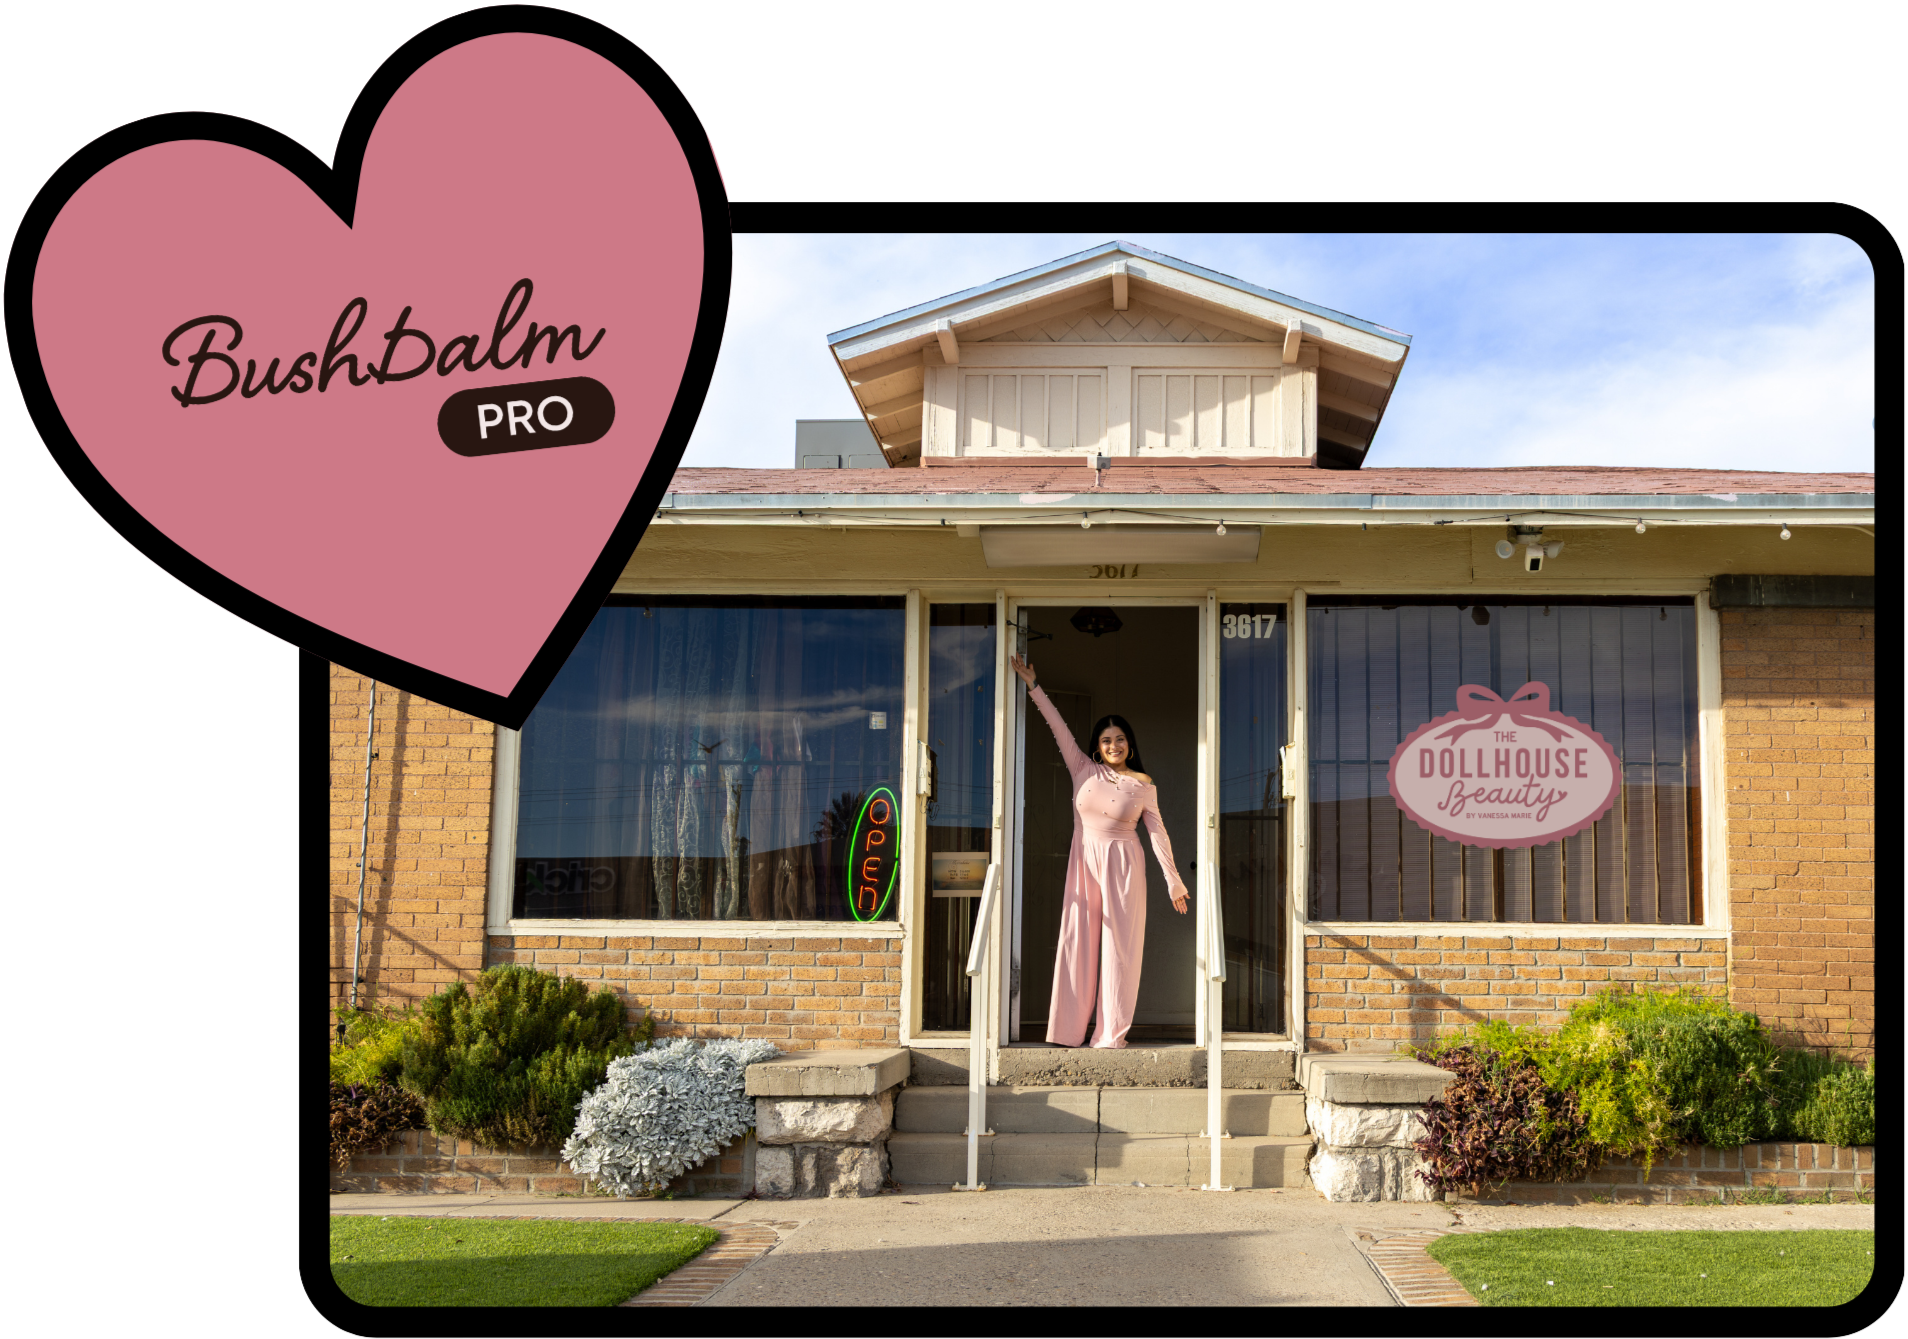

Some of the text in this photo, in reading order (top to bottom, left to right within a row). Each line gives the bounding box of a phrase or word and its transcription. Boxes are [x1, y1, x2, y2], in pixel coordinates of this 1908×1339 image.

[1222, 614, 1277, 639] 3617
[1493, 731, 1517, 743] THE
[1419, 748, 1588, 778] DOLLHOUSE
[1437, 773, 1567, 822] Beauty
